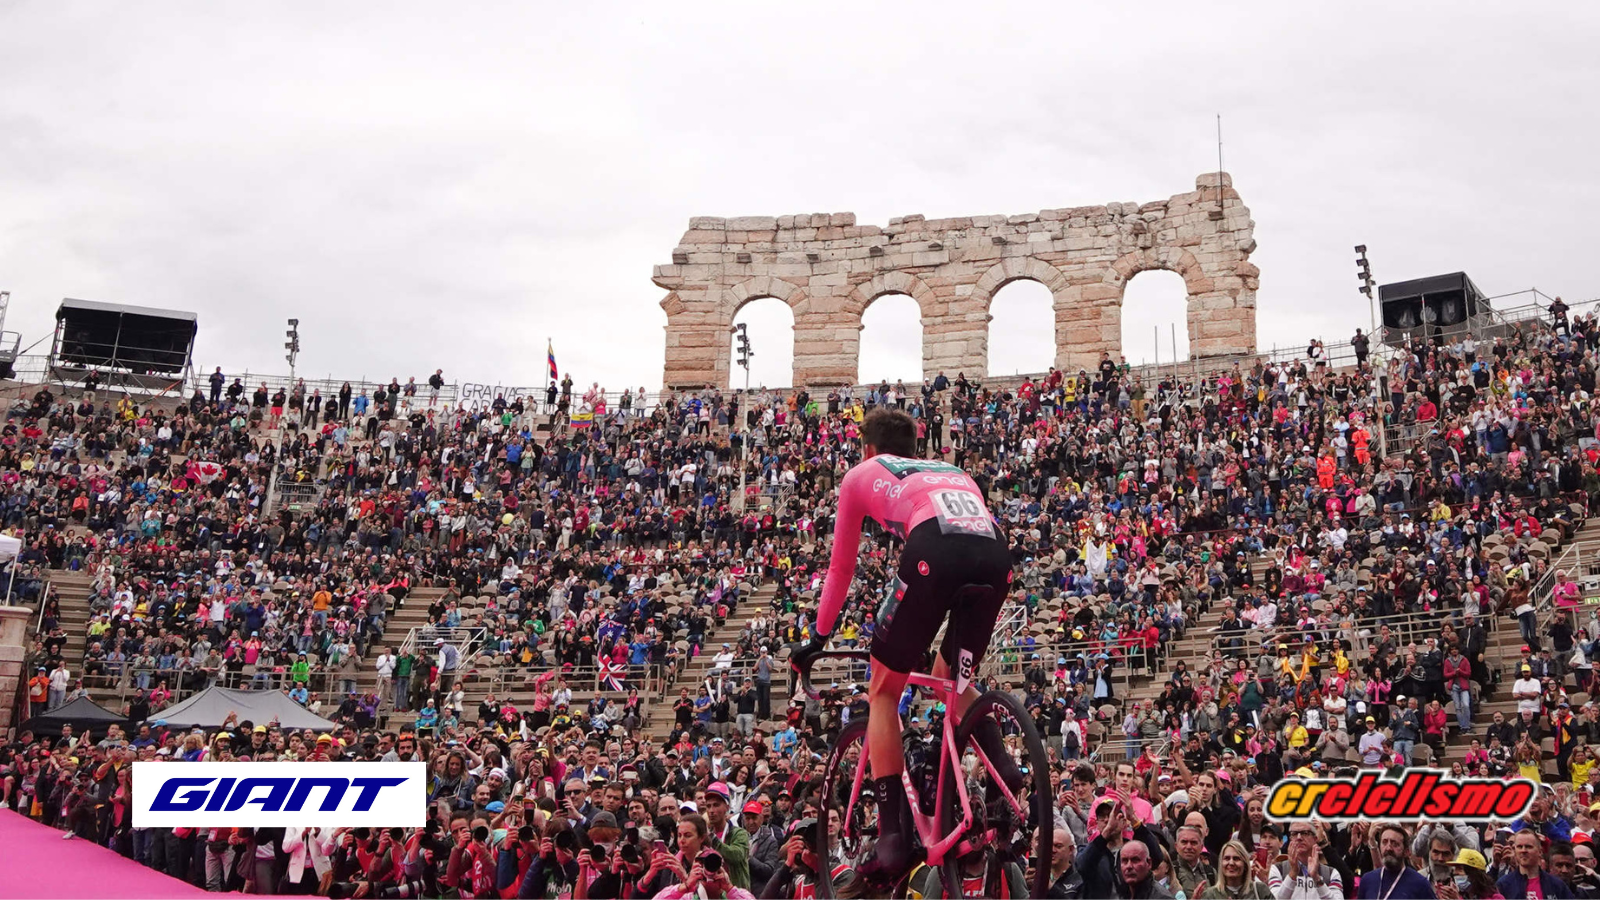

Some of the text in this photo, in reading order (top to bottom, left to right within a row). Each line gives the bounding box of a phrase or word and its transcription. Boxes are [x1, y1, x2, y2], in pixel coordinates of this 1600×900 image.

[462, 383, 526, 401] GRACIAS
[872, 478, 909, 499] enel
[923, 474, 971, 488] enel
[942, 491, 980, 516] 66
[960, 656, 972, 680] 66
